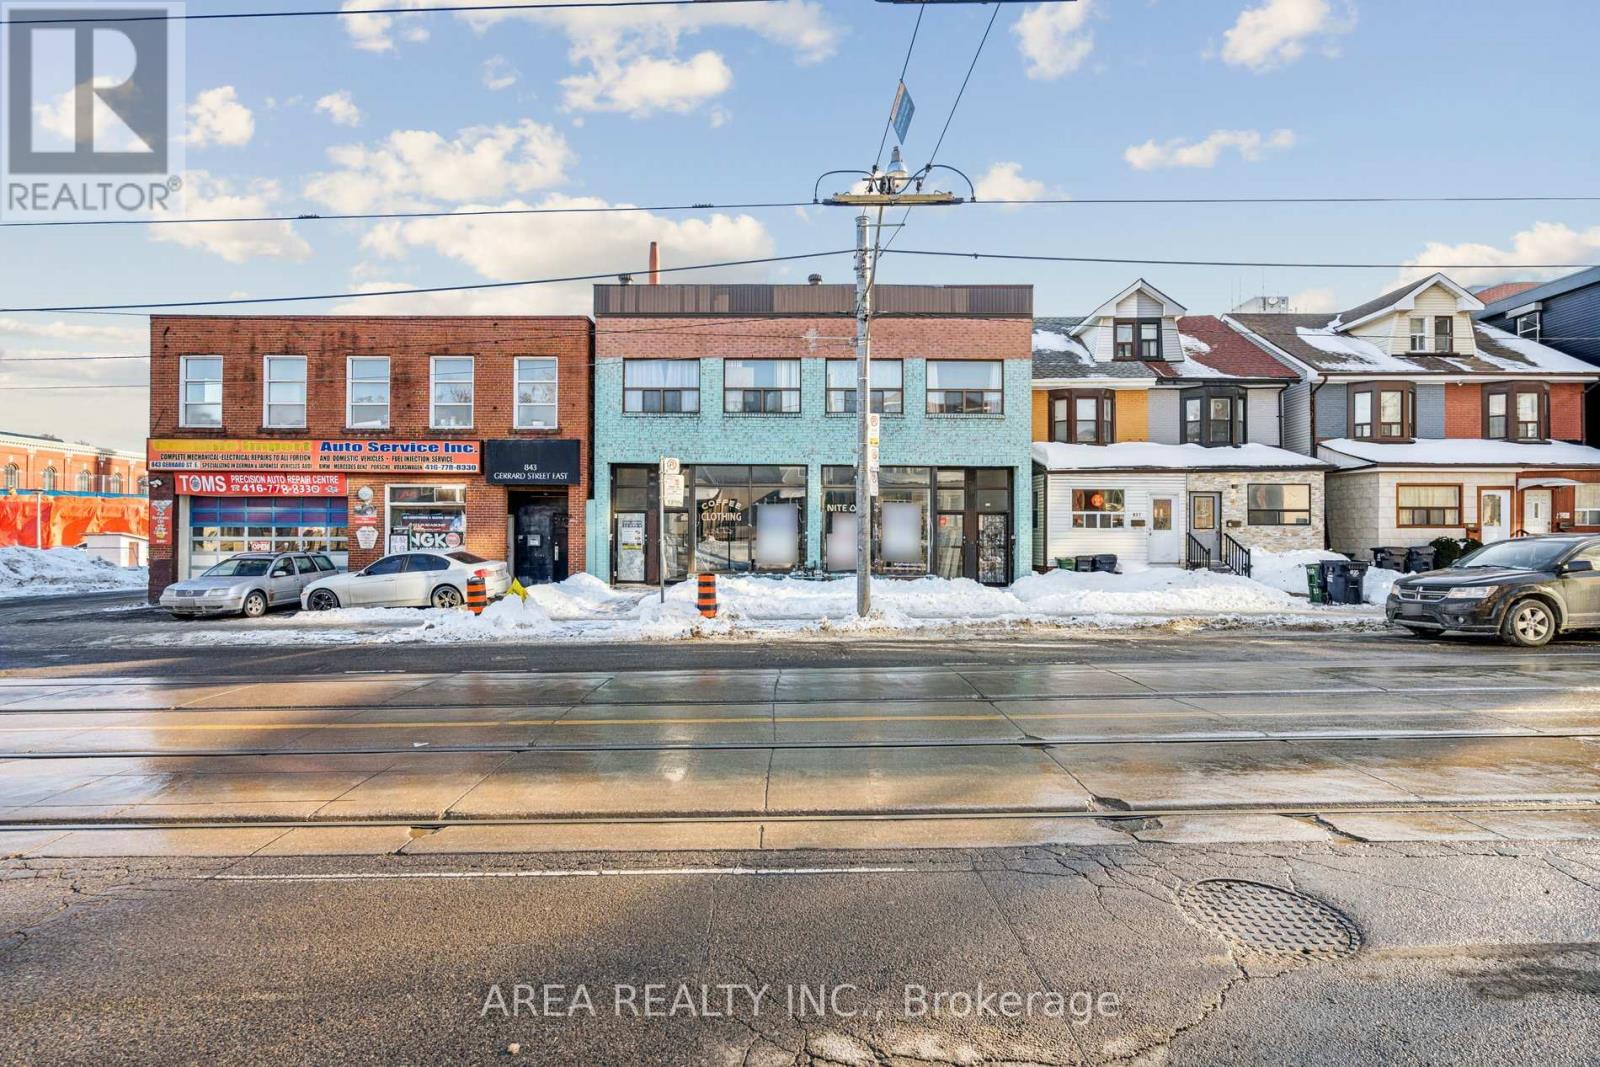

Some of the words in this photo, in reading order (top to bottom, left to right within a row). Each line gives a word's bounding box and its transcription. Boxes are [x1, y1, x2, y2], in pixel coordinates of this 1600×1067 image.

[320, 441, 363, 452] Auto
[367, 441, 439, 452] Service
[444, 442, 478, 453] Inc.
[432, 455, 453, 463] SERVICE
[230, 474, 266, 484] PRECISION
[267, 475, 286, 484] AUTO
[287, 475, 311, 484] REPAIR
[312, 475, 339, 484] CENTRE
[493, 472, 526, 480] GERRARD
[527, 472, 550, 480] STREET
[552, 472, 568, 480] EAST
[179, 475, 227, 492] TOMS
[242, 484, 320, 494] 416-778-8330
[701, 499, 742, 510] COFFEE
[826, 504, 847, 512] NITE
[701, 512, 742, 521] CLOTHING
[411, 533, 448, 548] NGK
